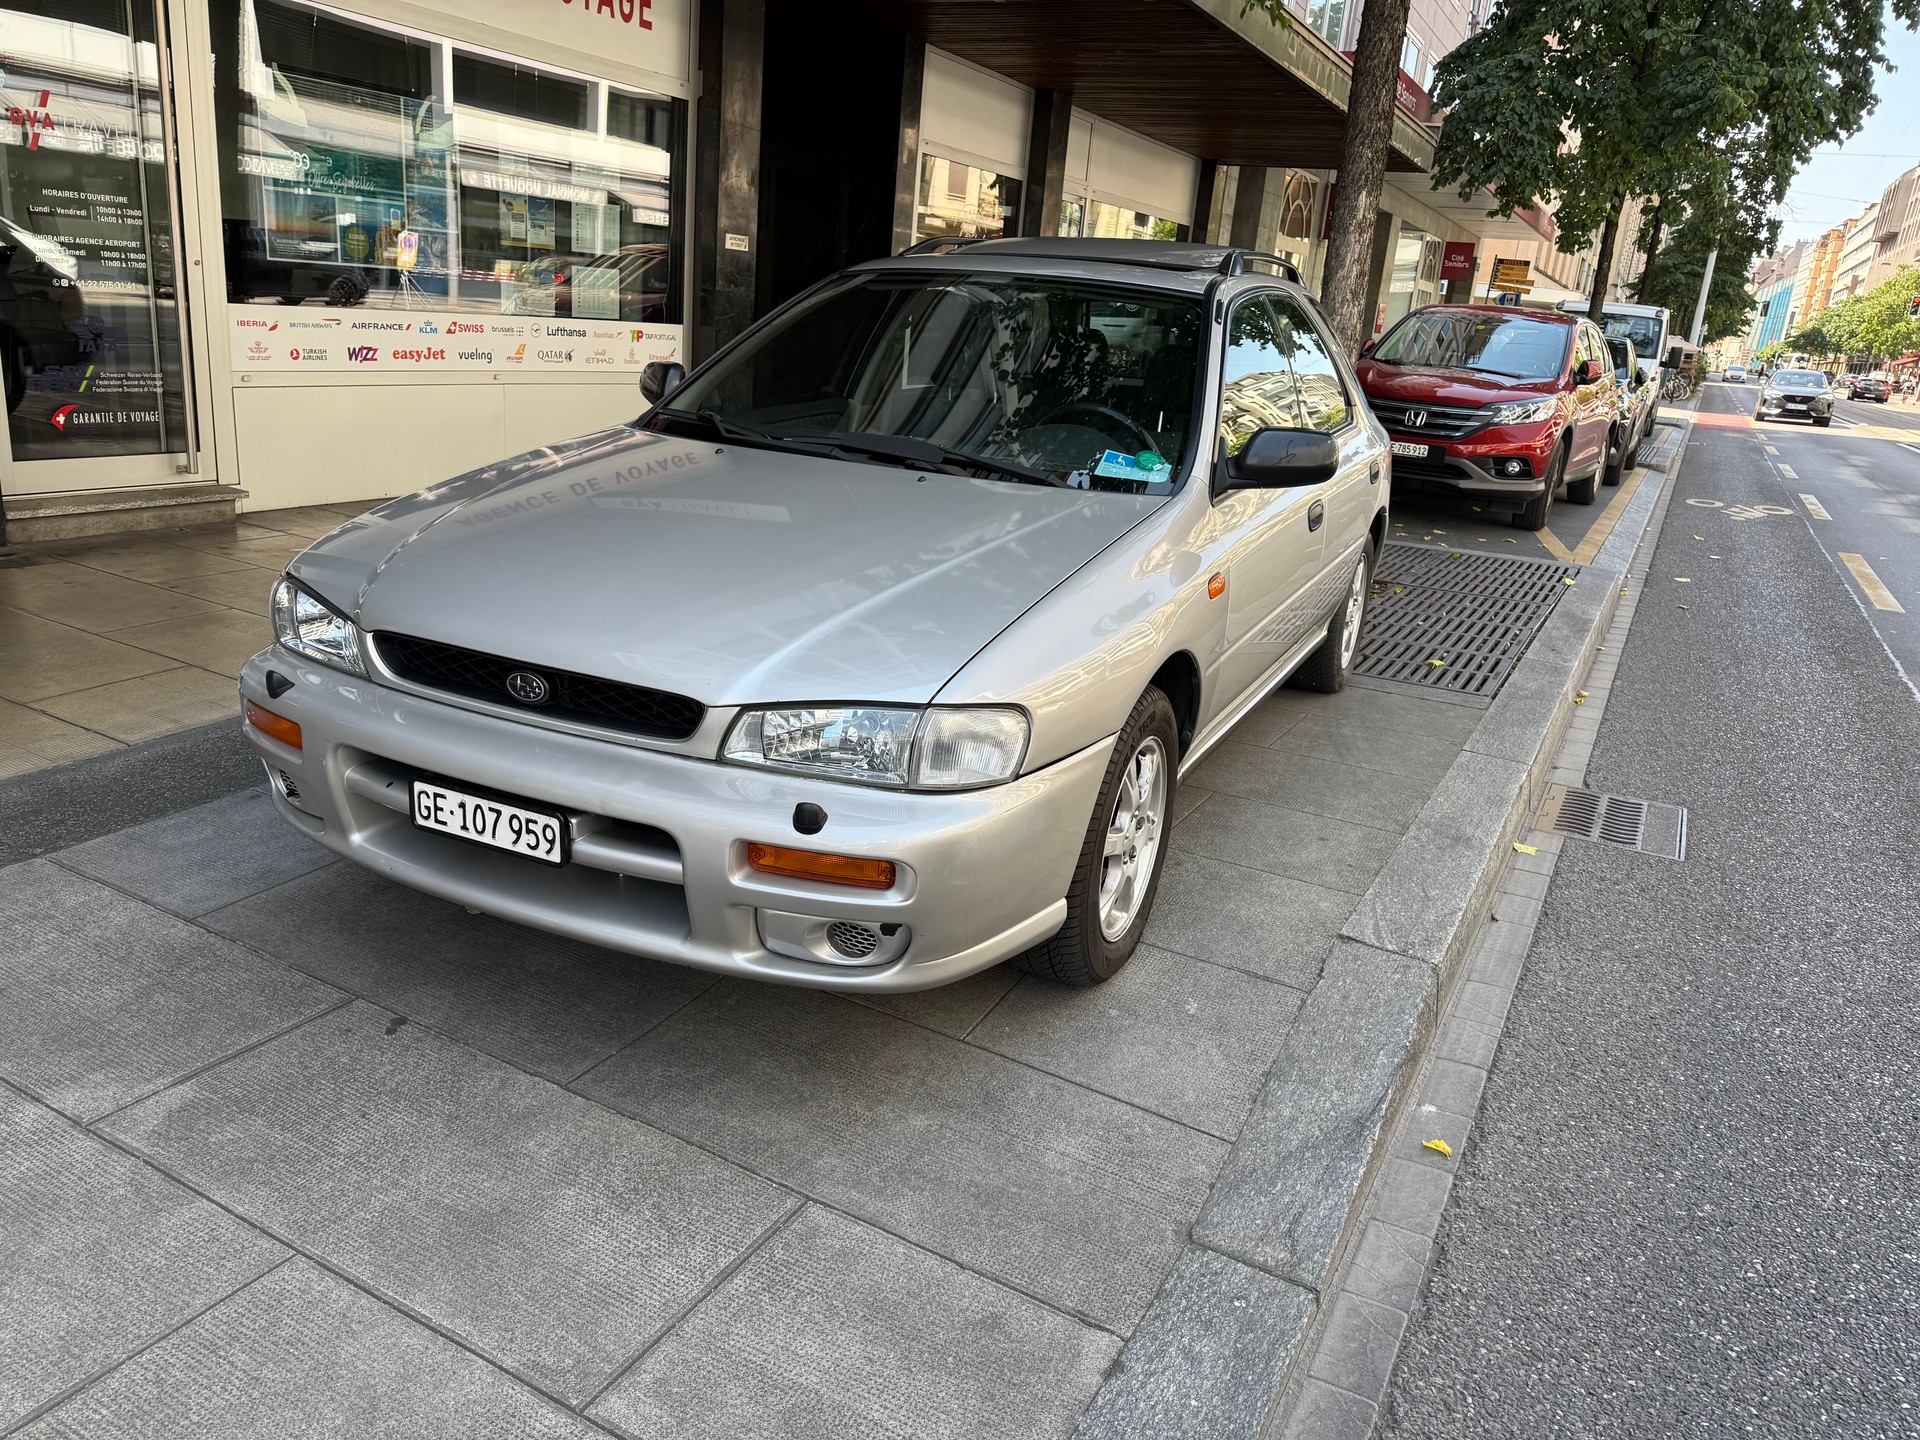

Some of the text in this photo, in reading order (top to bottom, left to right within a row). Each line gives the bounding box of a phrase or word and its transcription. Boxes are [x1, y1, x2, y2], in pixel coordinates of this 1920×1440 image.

[9, 107, 55, 131] GVA
[42, 188, 129, 204] HORAIRES D'OUVERTURE
[29, 204, 51, 214] Lundi
[56, 206, 88, 217] Vendredi
[96, 205, 116, 215] 10h00
[96, 215, 117, 224] 14h00
[123, 217, 143, 226] 18h00
[37, 233, 141, 249] HORAIRES AGENCE AEROPORT
[100, 250, 120, 259] 10h00
[1451, 254, 1465, 262] Cité
[100, 259, 121, 268] 11h00
[1444, 260, 1470, 269] Seniors
[236, 319, 268, 328] IBERIA
[351, 321, 404, 332] AIRFRANCE
[458, 323, 485, 334] SWISS
[419, 326, 438, 335] KLM
[491, 325, 515, 334] brussels
[546, 325, 587, 338] Lufthansa
[392, 346, 446, 363] easyJet
[458, 348, 493, 364] vueling
[537, 349, 564, 361] QATAR
[585, 357, 614, 365] ETIHAD
[100, 371, 126, 379] Schweizer
[92, 386, 123, 394] Federazione
[123, 386, 143, 394] Svizzera
[73, 410, 160, 425] GARANTIE DE VOYAGE
[1412, 445, 1427, 456] 912
[508, 813, 557, 857] 959
